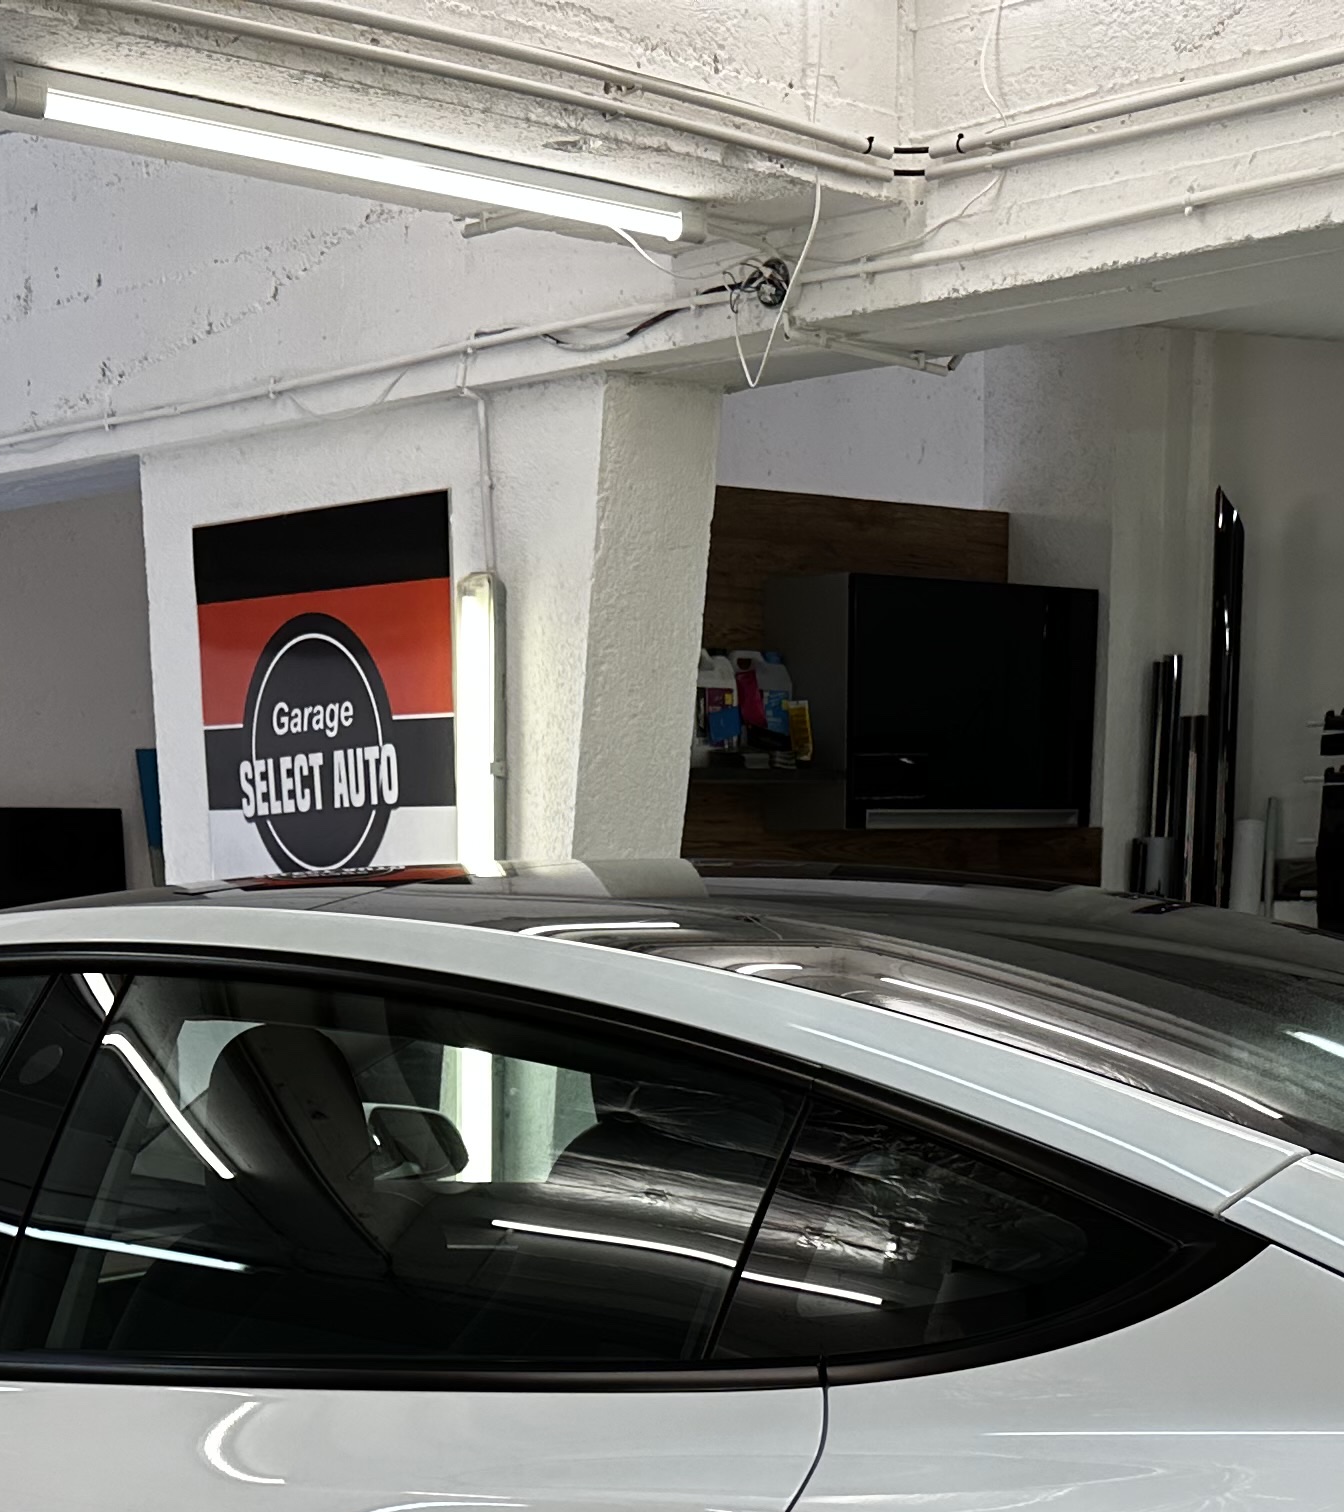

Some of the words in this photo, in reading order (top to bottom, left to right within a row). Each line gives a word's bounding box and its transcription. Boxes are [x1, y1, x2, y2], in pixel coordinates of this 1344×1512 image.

[272, 700, 354, 738] Garage
[239, 752, 324, 818] SELECT
[333, 743, 399, 809] AUTO
